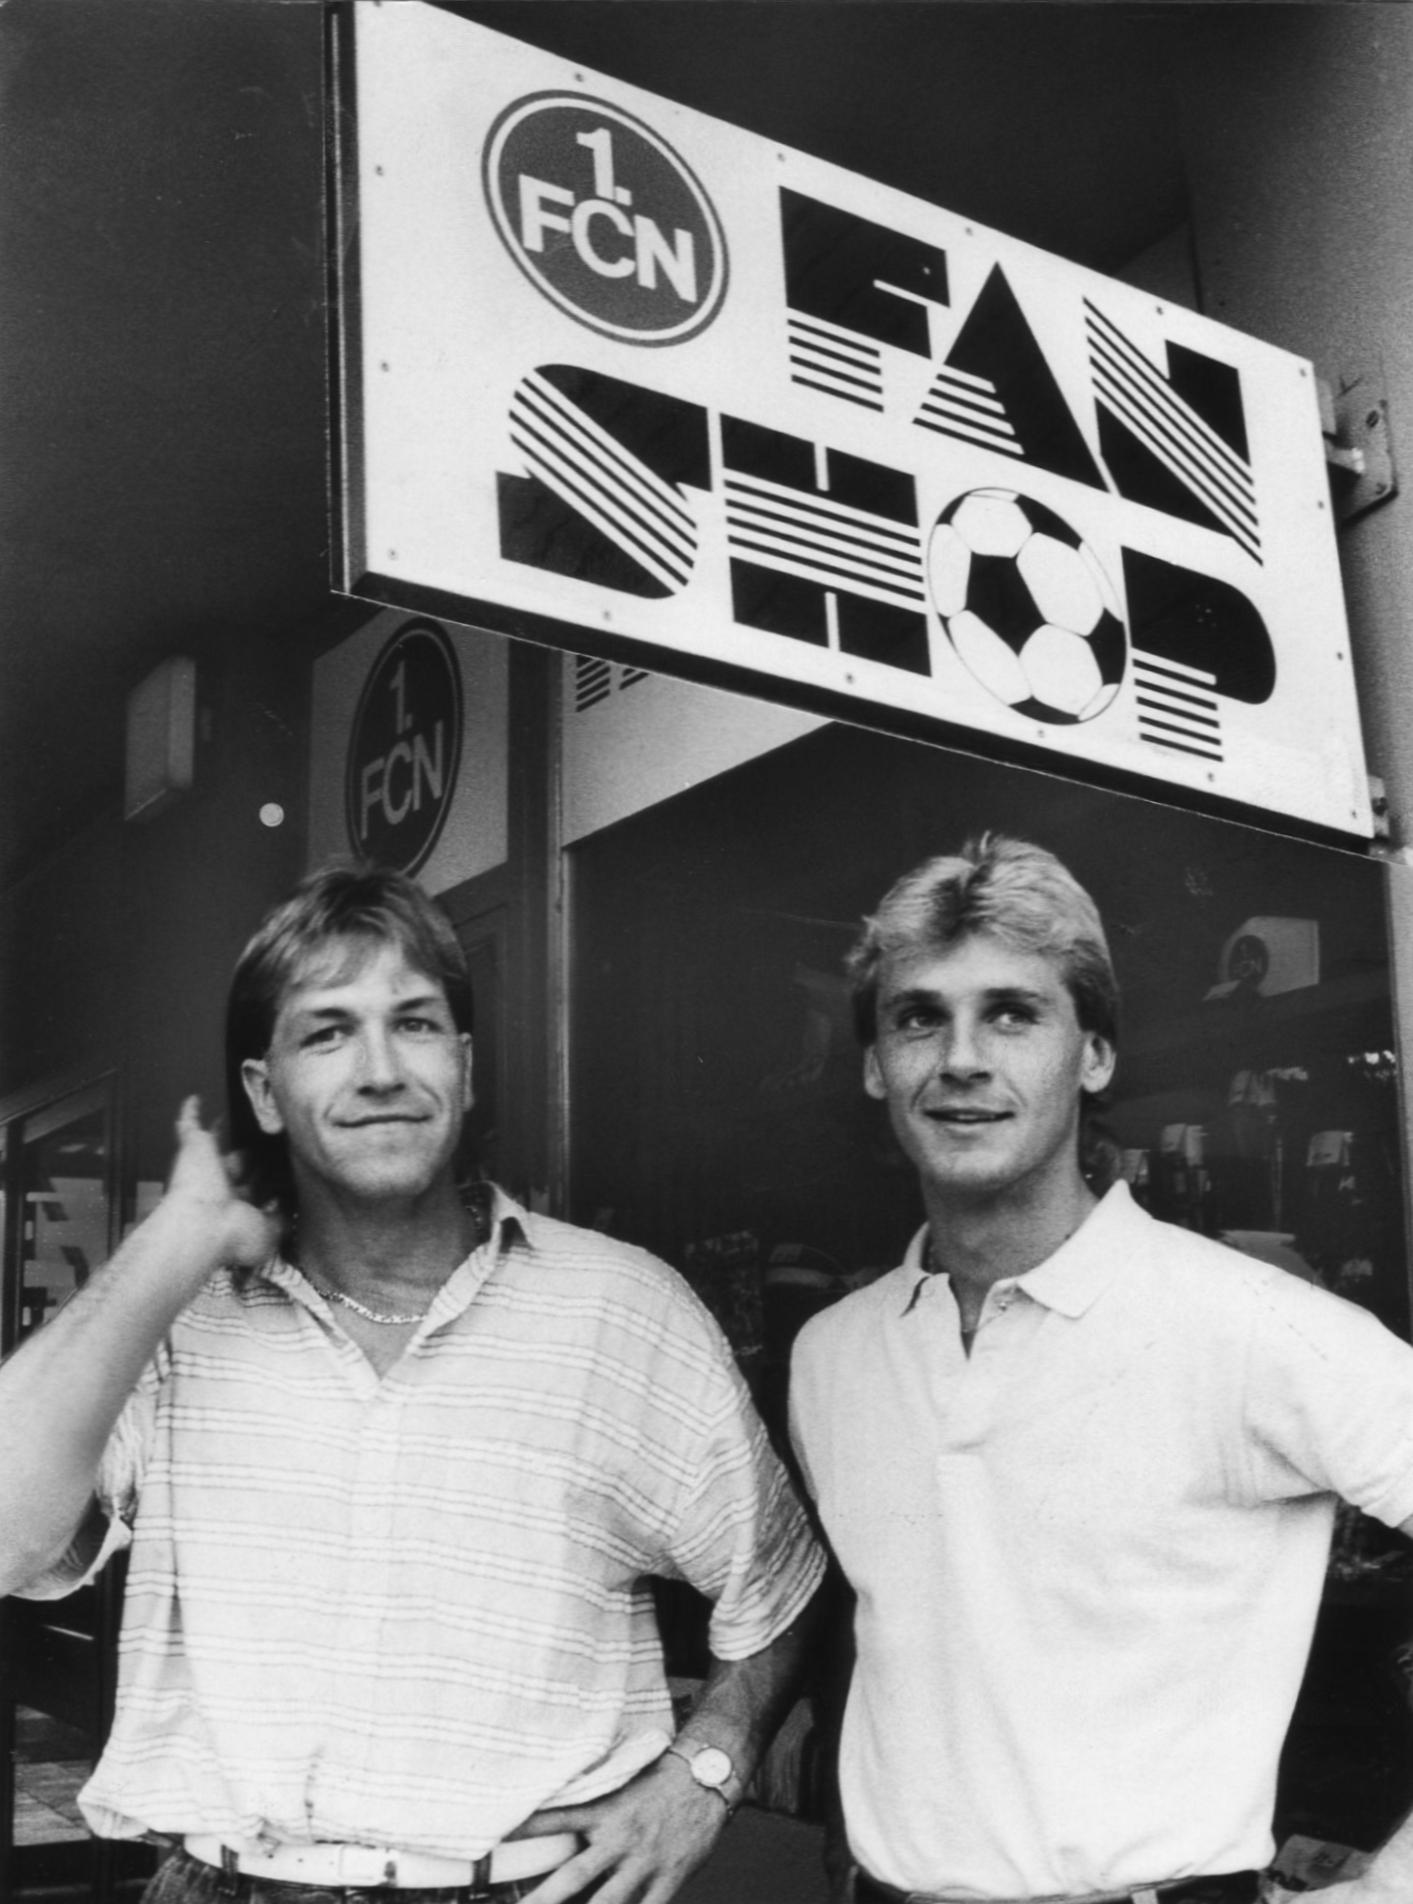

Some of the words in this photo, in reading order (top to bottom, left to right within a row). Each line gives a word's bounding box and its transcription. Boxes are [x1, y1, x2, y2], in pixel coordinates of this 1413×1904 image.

[576, 127, 632, 206] 1.
[518, 173, 698, 303] FCN
[778, 184, 1264, 568] FAN
[388, 660, 414, 736] 1.
[361, 719, 443, 840] FCN
